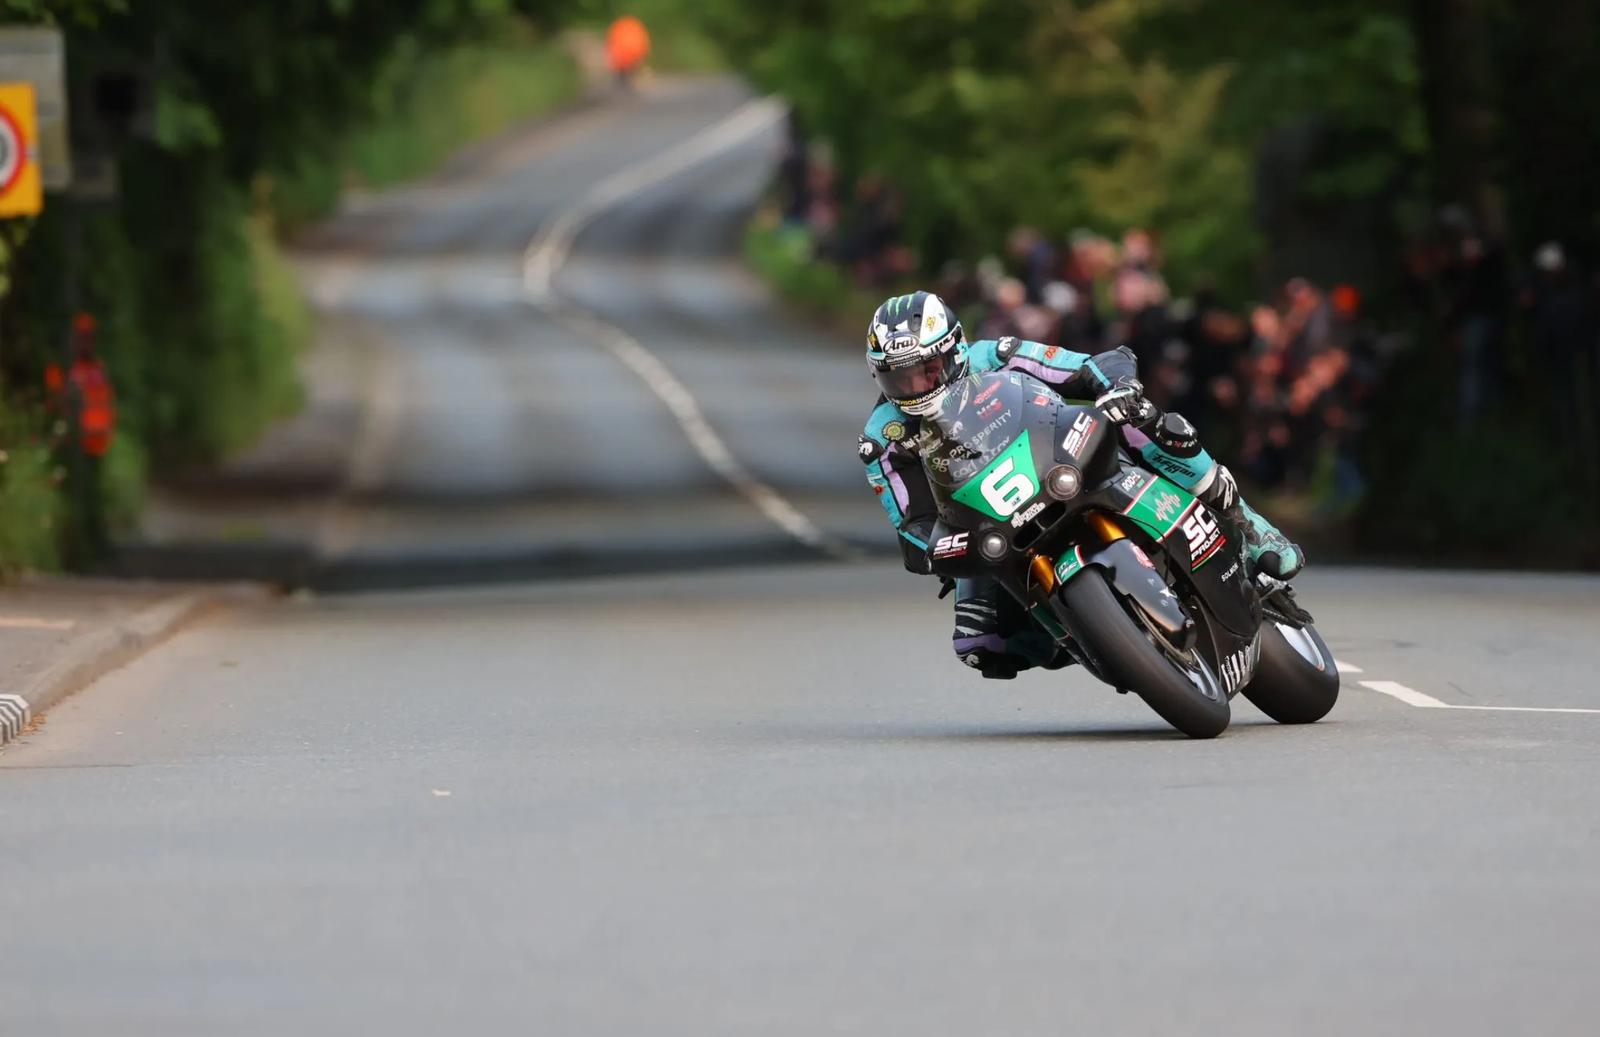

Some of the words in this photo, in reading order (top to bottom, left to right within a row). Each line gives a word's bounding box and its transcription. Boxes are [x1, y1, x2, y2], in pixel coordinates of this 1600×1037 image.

[887, 336, 914, 352] Arai
[1062, 411, 1091, 451] SC
[980, 456, 1035, 517] 6
[934, 532, 970, 550] SC
[1182, 503, 1216, 552] SC
[933, 546, 967, 555] PROJECT
[1191, 529, 1221, 560] PROJECT
